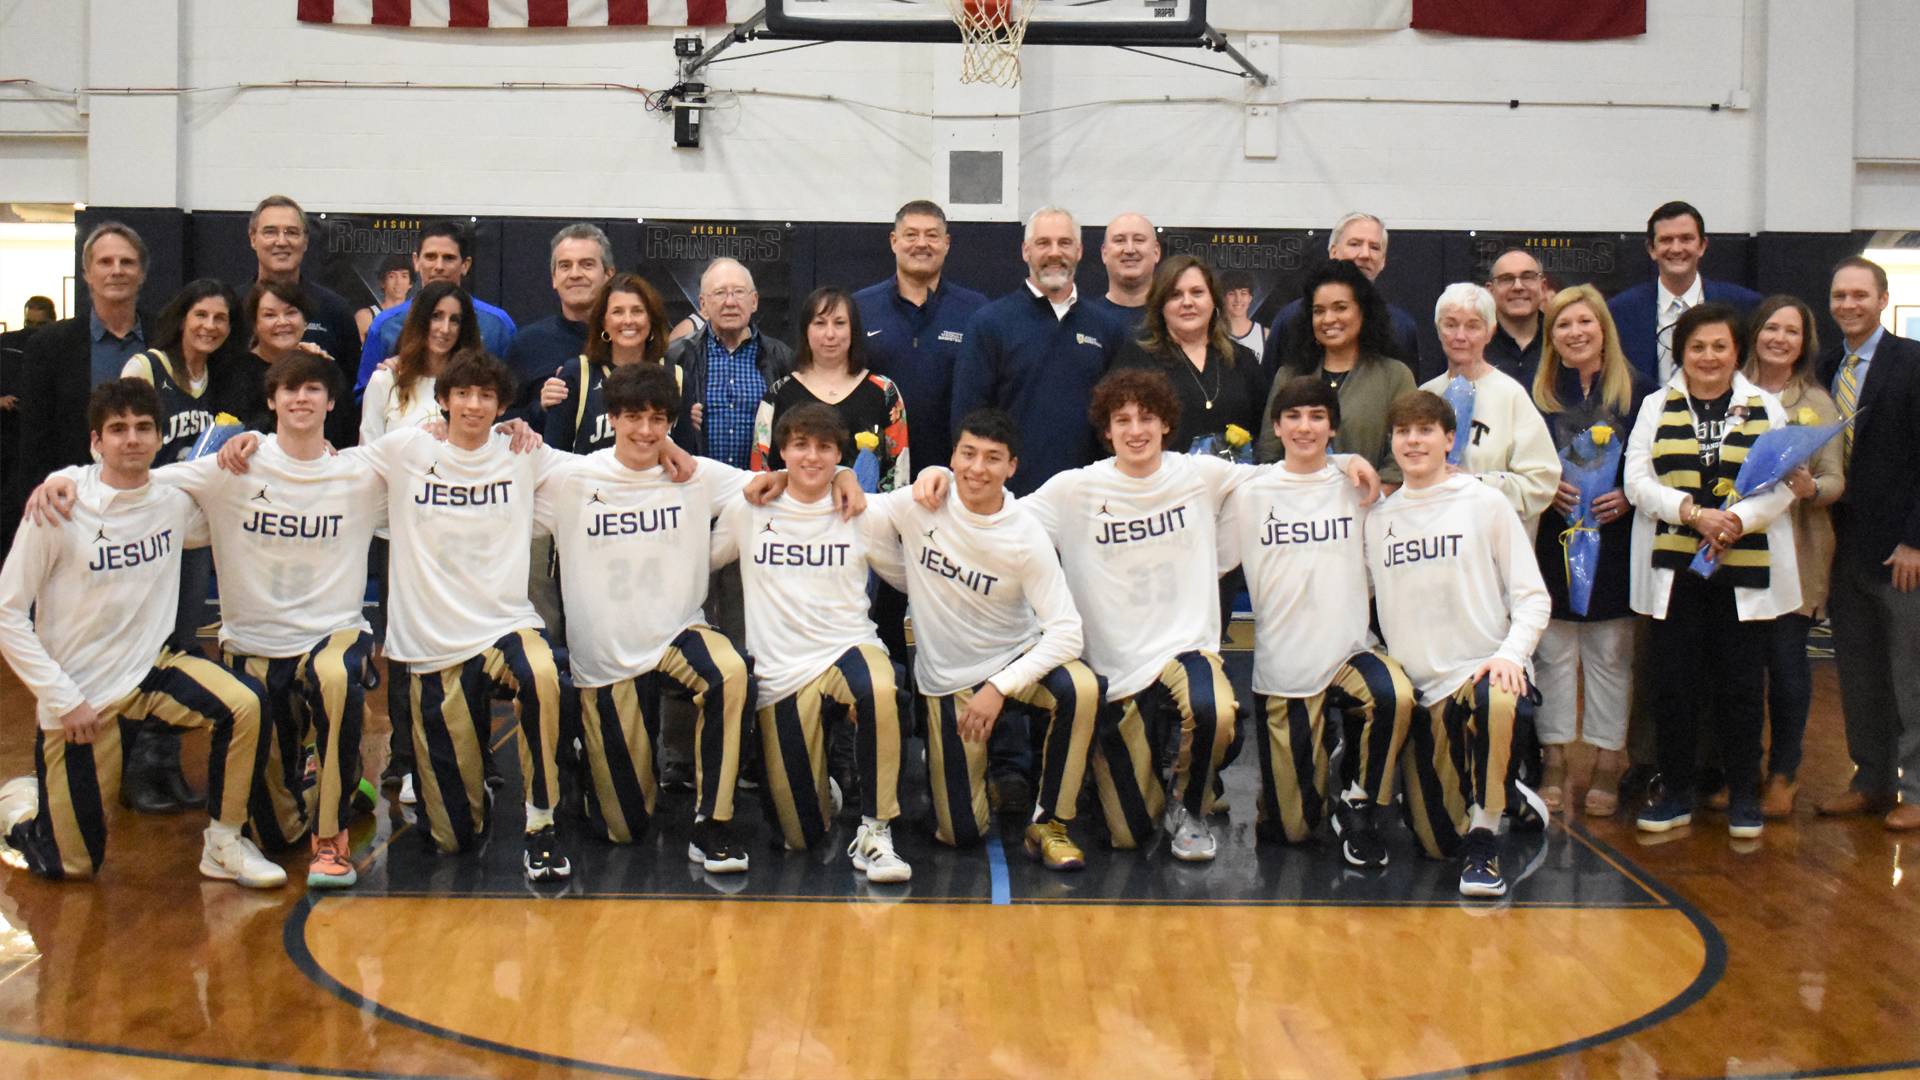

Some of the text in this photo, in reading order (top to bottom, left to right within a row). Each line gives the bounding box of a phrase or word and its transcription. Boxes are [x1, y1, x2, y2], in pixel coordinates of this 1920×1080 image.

[329, 220, 464, 253] RANG
[374, 220, 421, 229] JESUIT
[691, 225, 737, 235] JESUIT
[1212, 234, 1258, 244] JESUIT
[647, 225, 781, 261] RANGERS
[1480, 238, 1615, 273] RGERS
[1525, 238, 1571, 247] JESUIT
[414, 480, 513, 506] JESUIT
[243, 511, 343, 538] JESUIT
[587, 506, 682, 537] JESUIT
[1095, 505, 1186, 544] JESUIT
[1260, 517, 1353, 546] JESUIT
[89, 529, 172, 571] JESUIT
[753, 542, 850, 567] JESUIT
[1384, 534, 1463, 568] JESUIT
[919, 546, 998, 596] JESUIT
